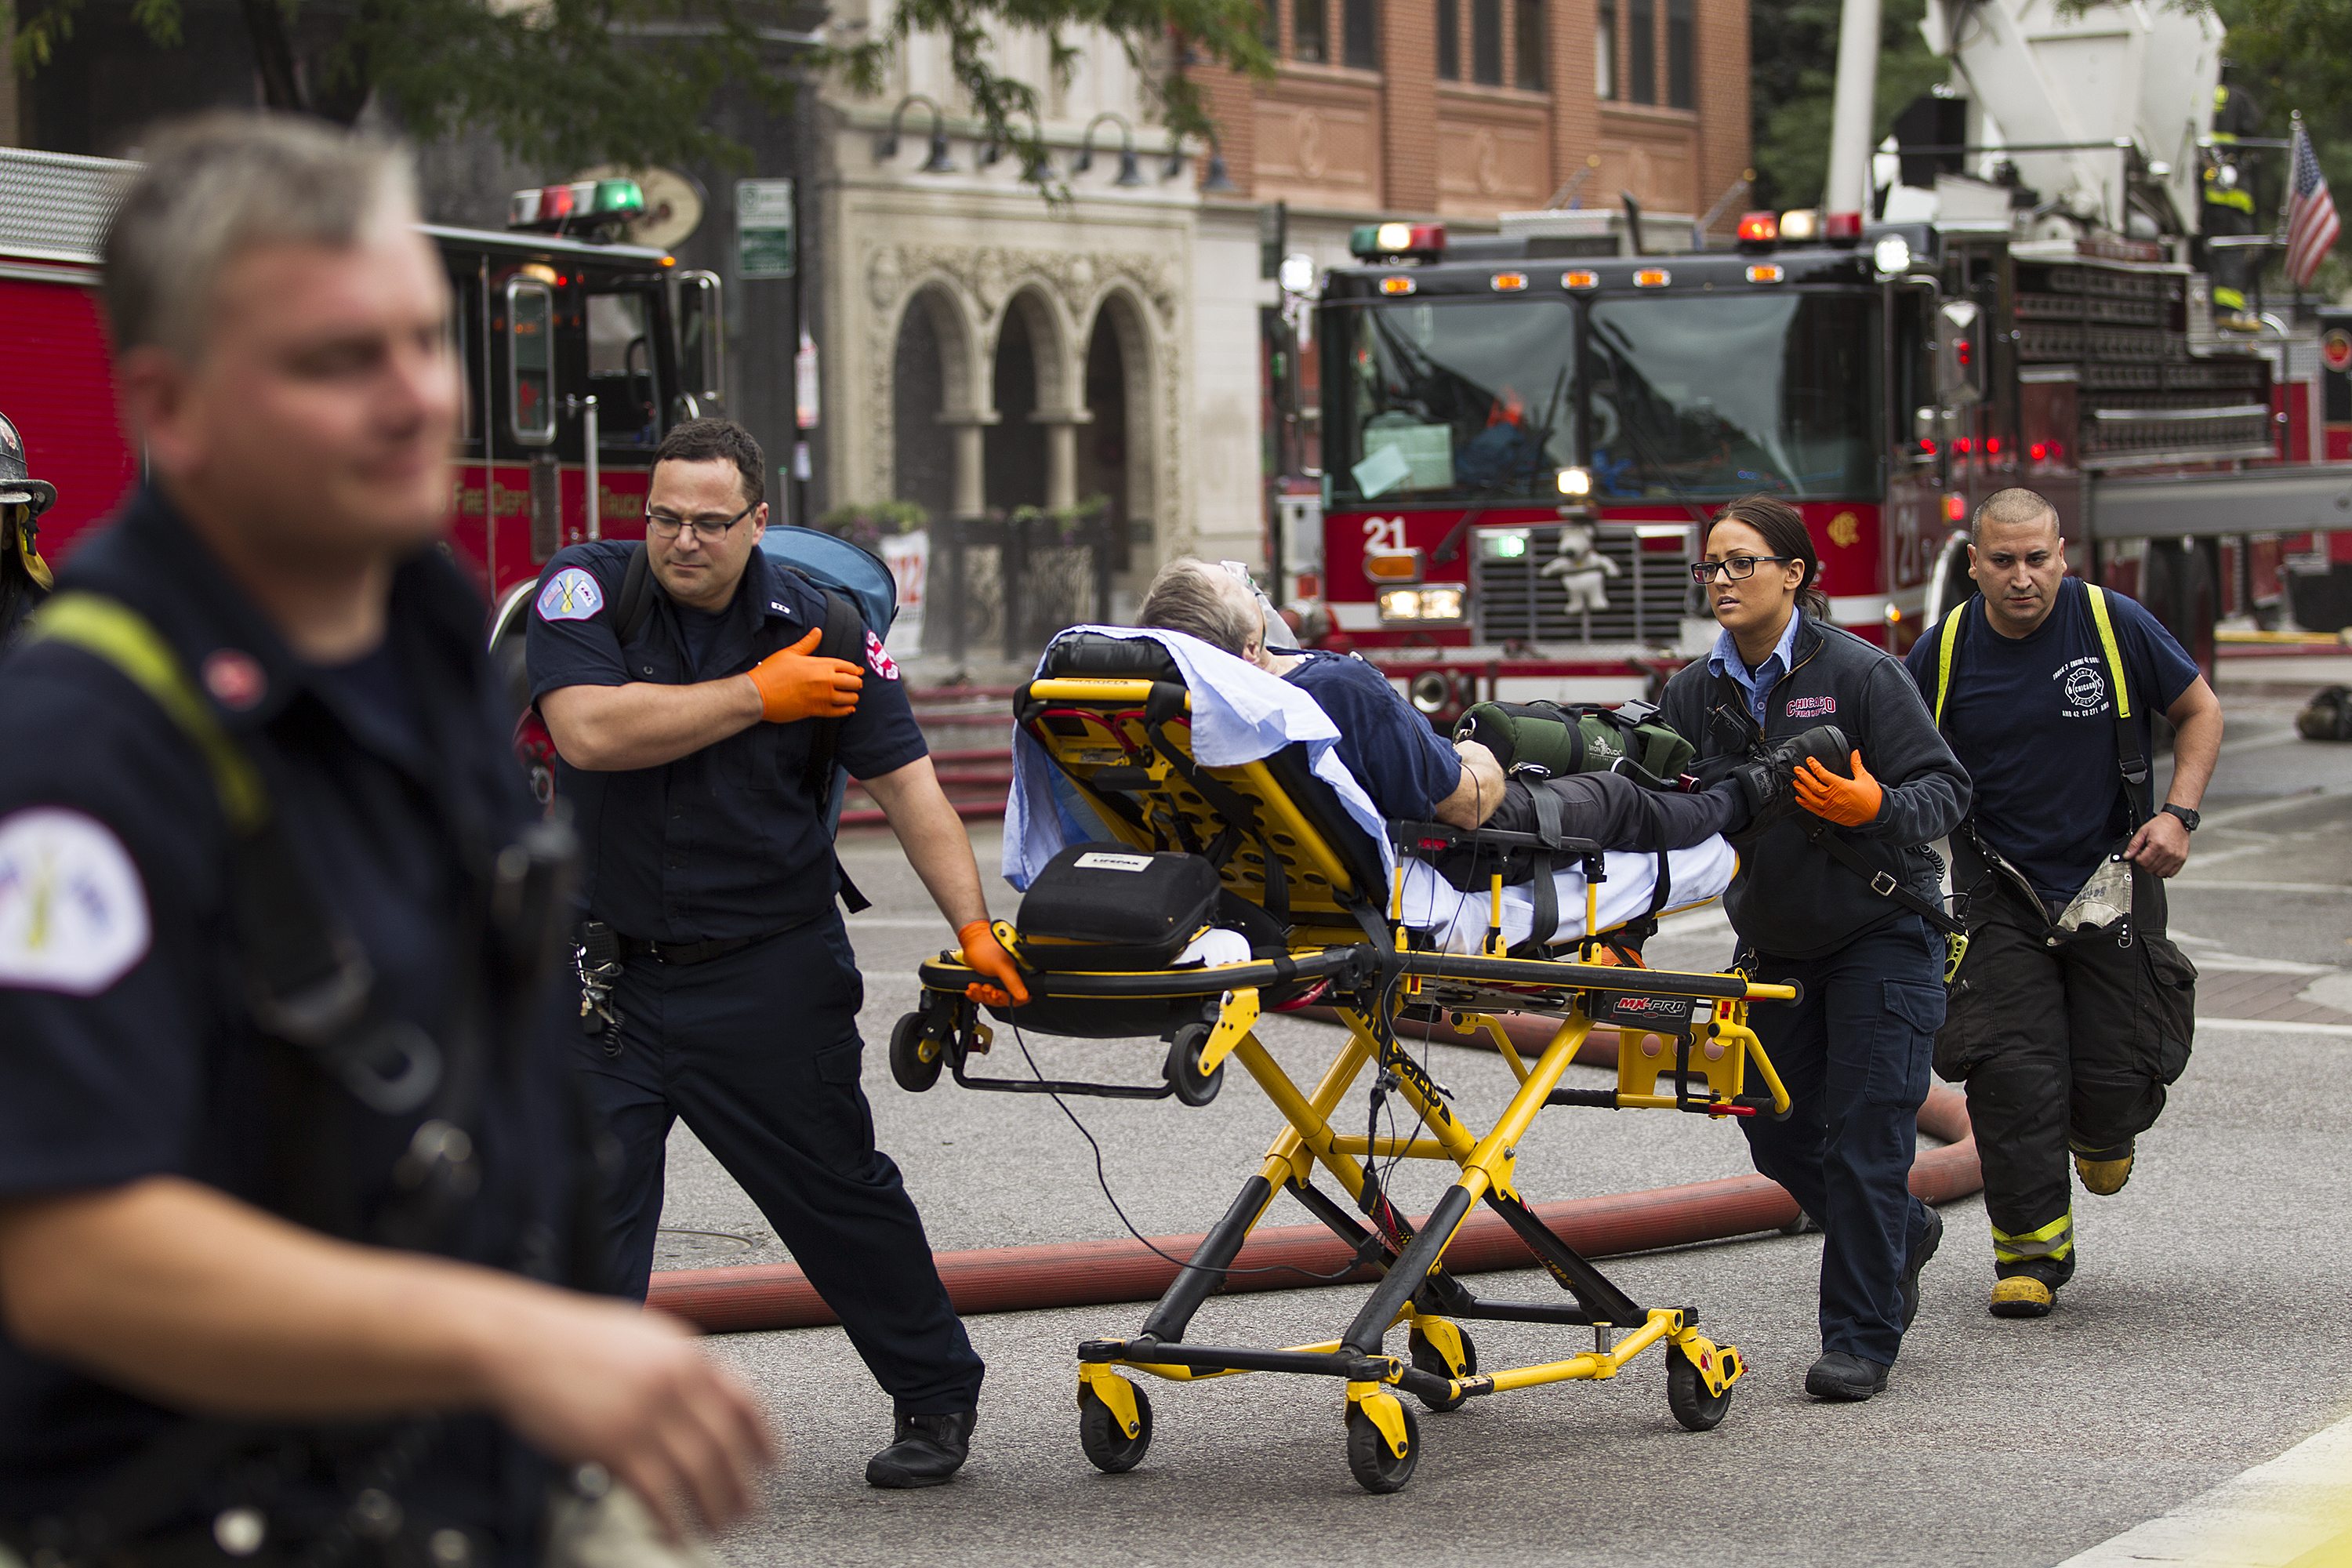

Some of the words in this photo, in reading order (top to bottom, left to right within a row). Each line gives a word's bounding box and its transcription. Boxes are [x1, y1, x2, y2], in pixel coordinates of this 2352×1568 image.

[1363, 516, 1406, 554] 21
[2074, 683, 2095, 693] CHICAGO
[1787, 696, 1835, 717] CHICAGO
[1617, 997, 1686, 1014] MX-PRO
